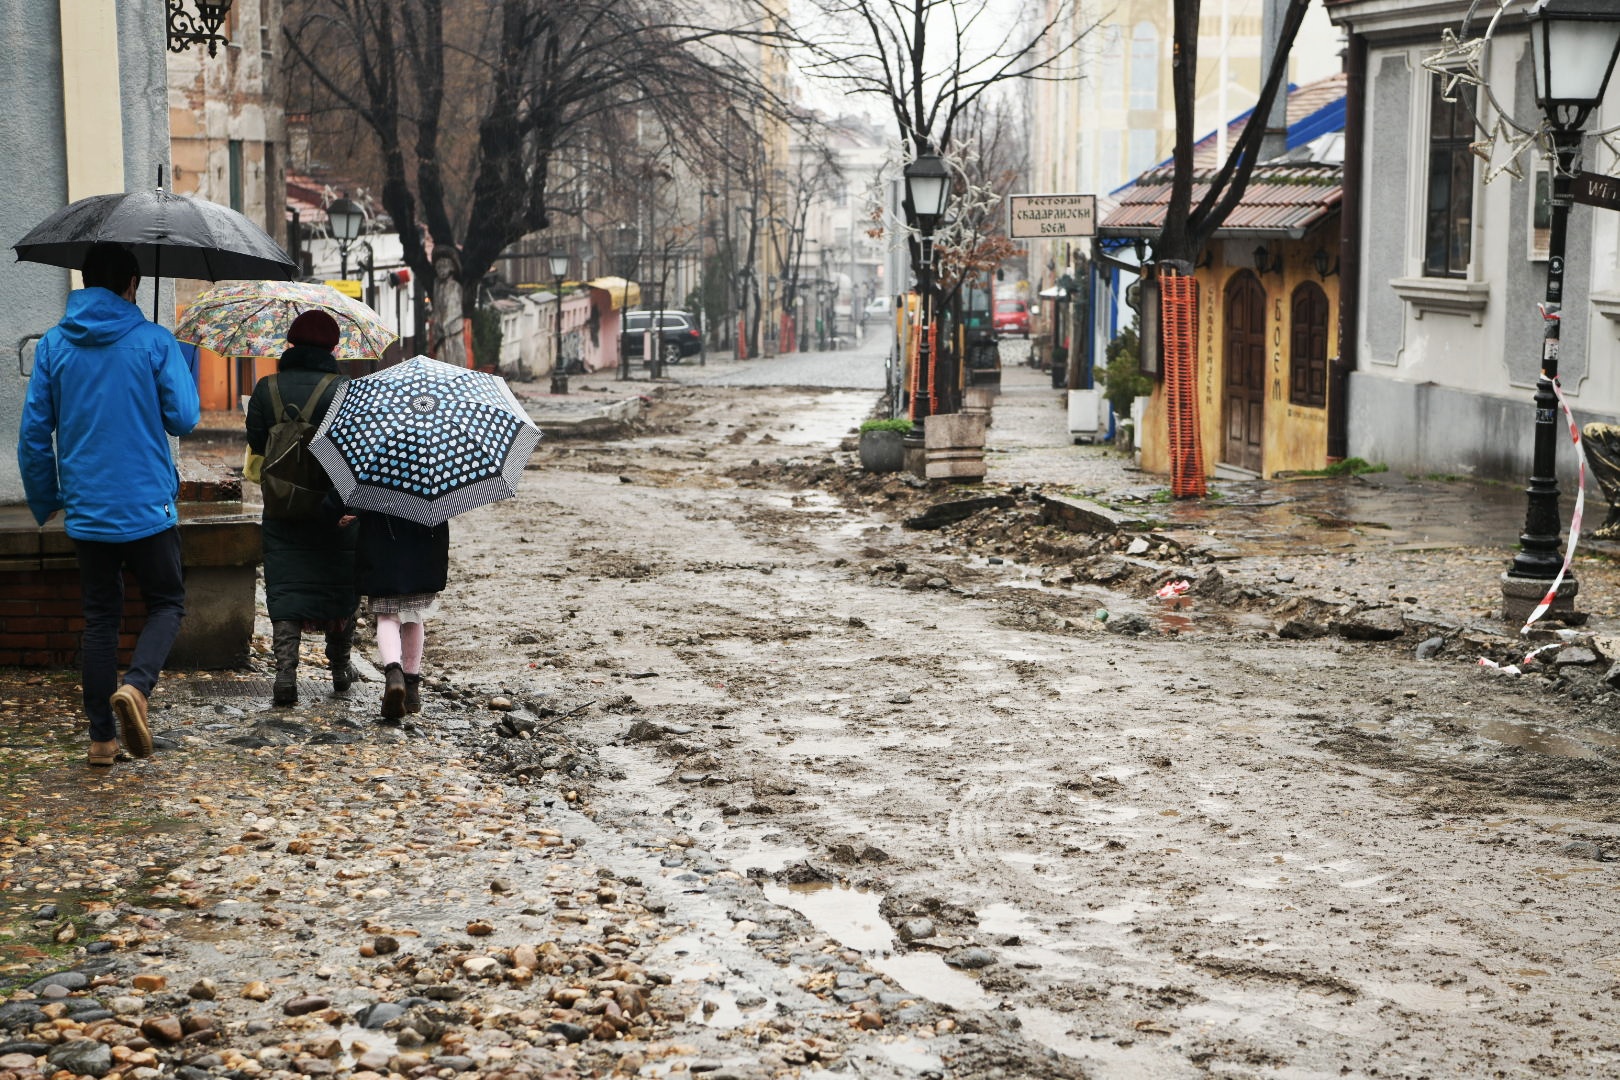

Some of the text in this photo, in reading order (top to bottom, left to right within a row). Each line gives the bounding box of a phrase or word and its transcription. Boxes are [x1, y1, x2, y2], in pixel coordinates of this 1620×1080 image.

[1028, 198, 1081, 206] РЕСТОРАН
[1040, 223, 1066, 233] БОЕМ
[1272, 299, 1281, 400] БОЕМ
